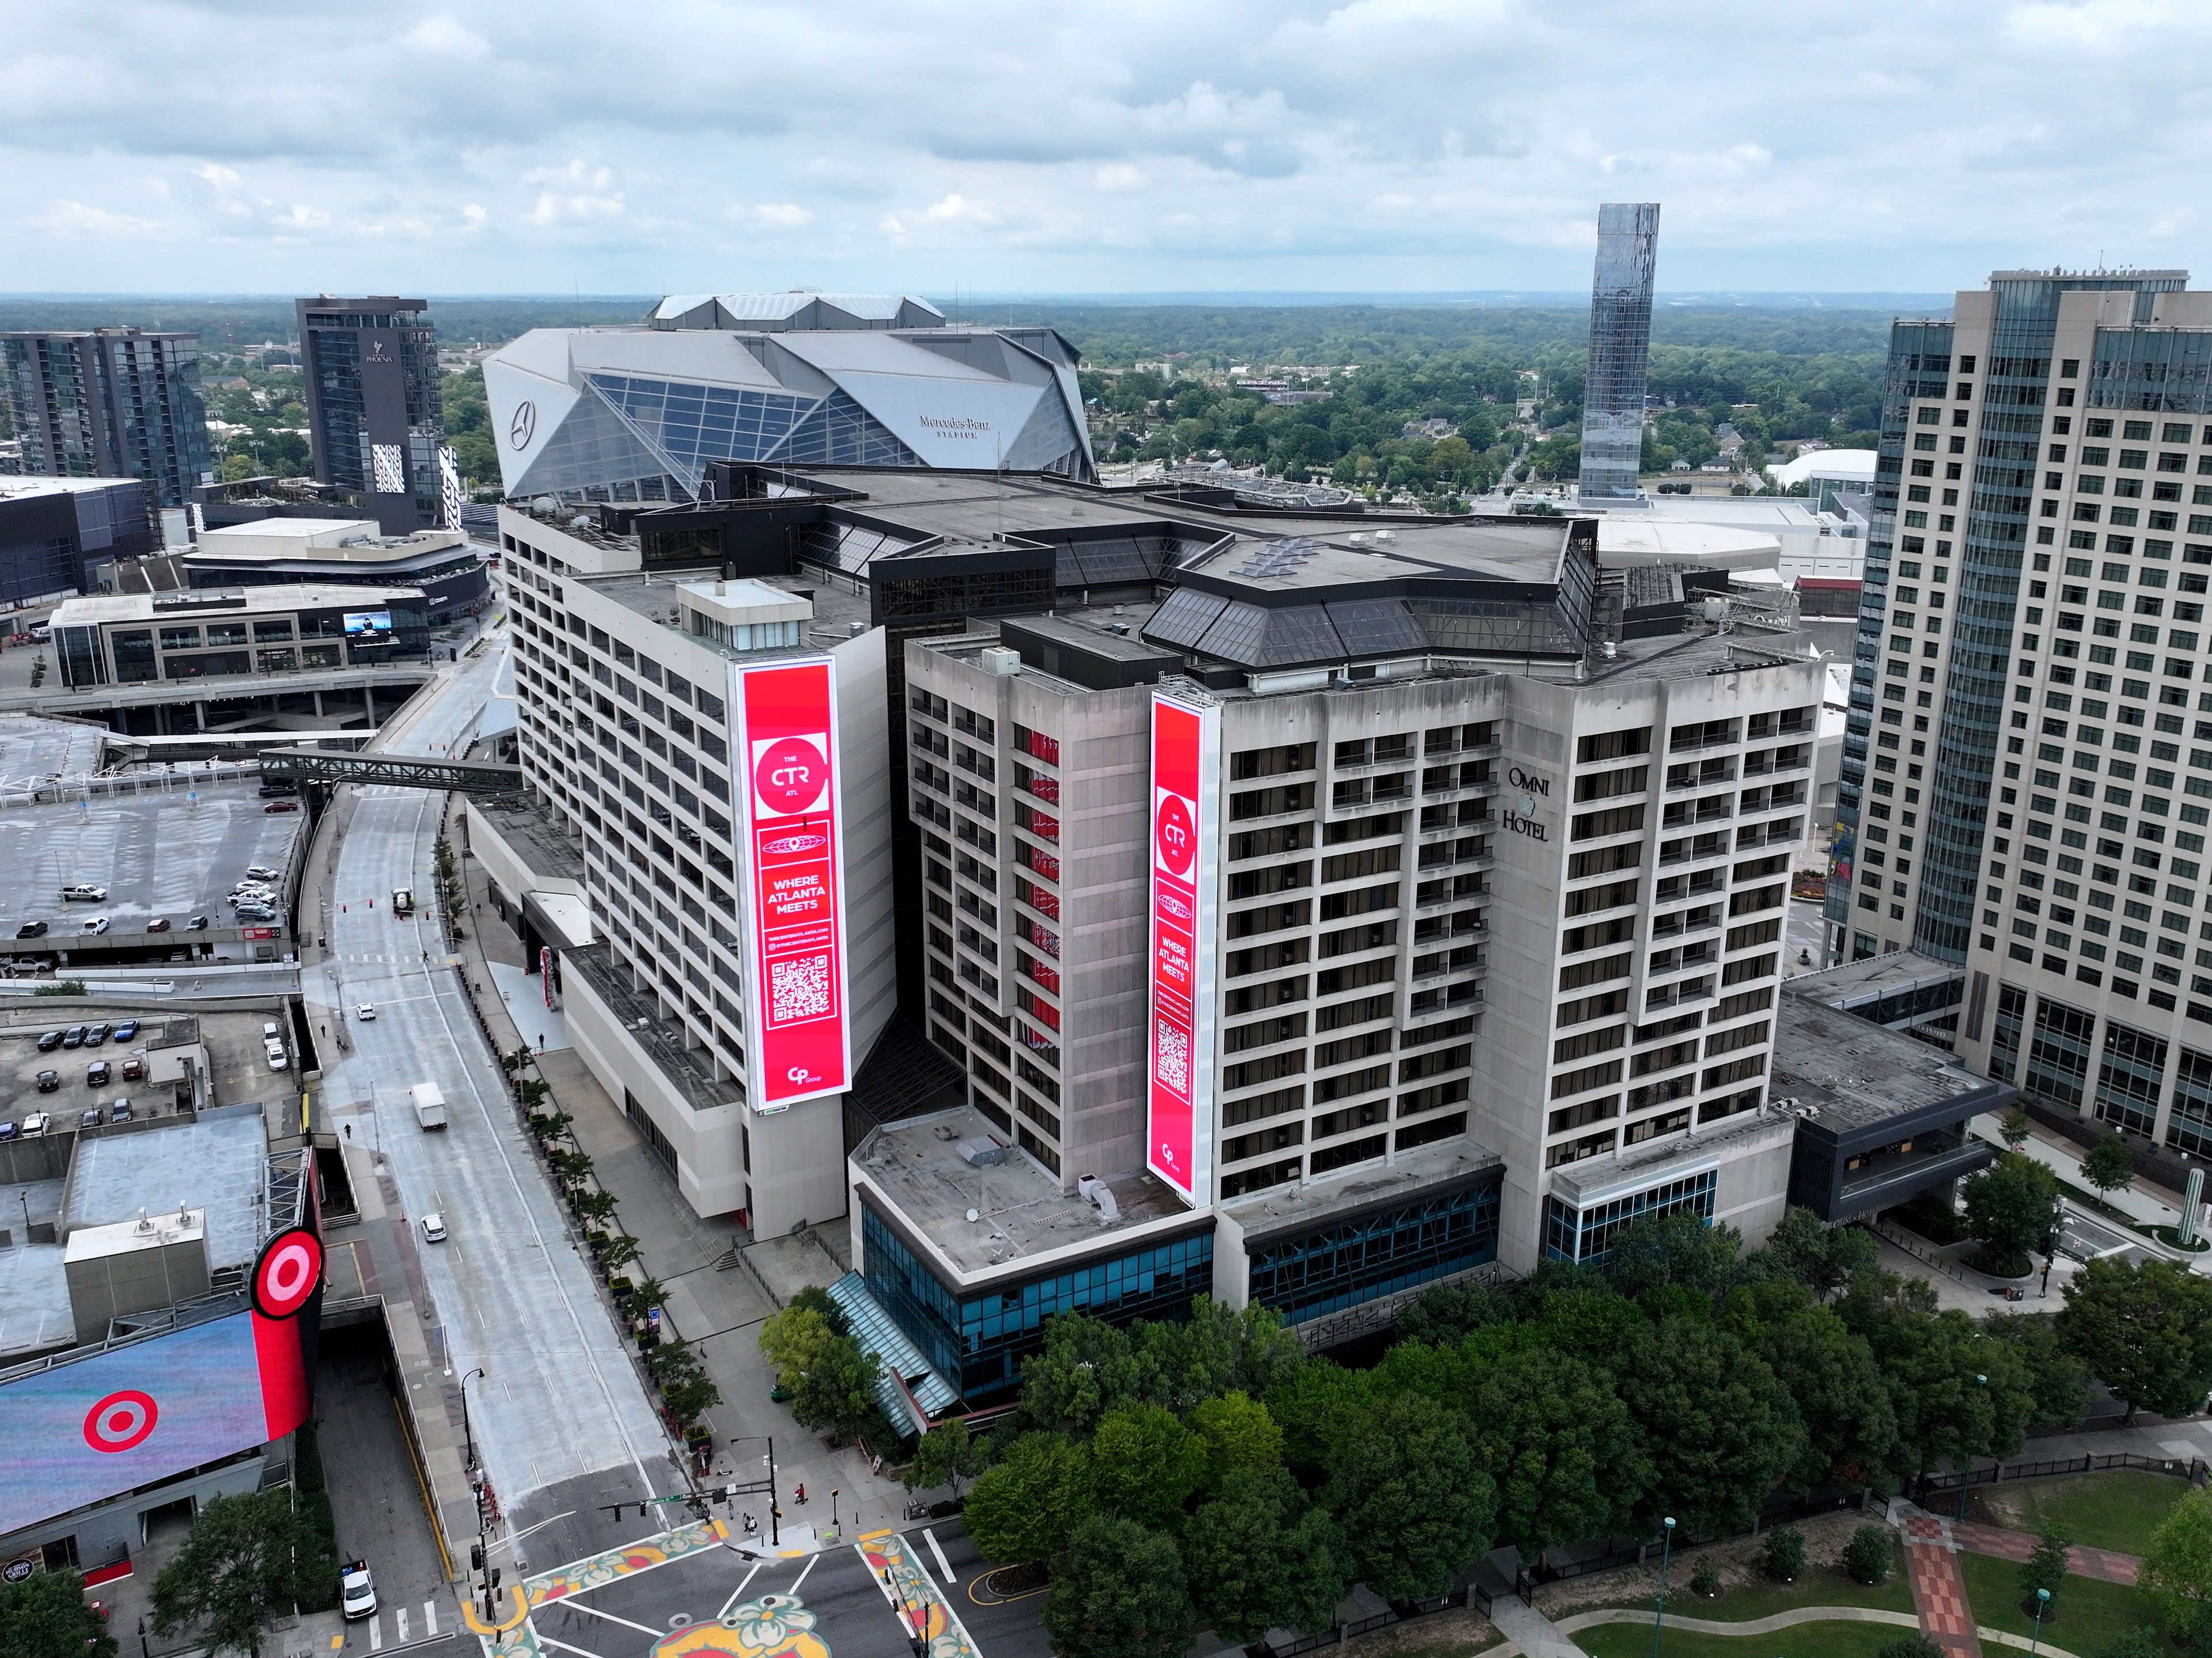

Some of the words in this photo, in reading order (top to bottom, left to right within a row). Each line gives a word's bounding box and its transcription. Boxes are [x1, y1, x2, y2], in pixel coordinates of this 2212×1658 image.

[920, 415, 990, 430] Mercedes-Benz
[937, 431, 978, 439] STADIUM
[772, 766, 809, 786] CTR
[1509, 768, 1550, 796] OMNI
[1502, 809, 1548, 842] HOTEL
[1165, 823, 1185, 848] CTR
[1171, 849, 1179, 858] ATL
[774, 875, 819, 890] WHERE
[768, 886, 826, 904] ATLANTA
[777, 900, 818, 915] MEETS
[1162, 935, 1186, 958] WHERE
[1158, 947, 1190, 973] ATLANTA
[1162, 961, 1185, 982] MEETS
[6, 1562, 29, 1575] HUDSON
